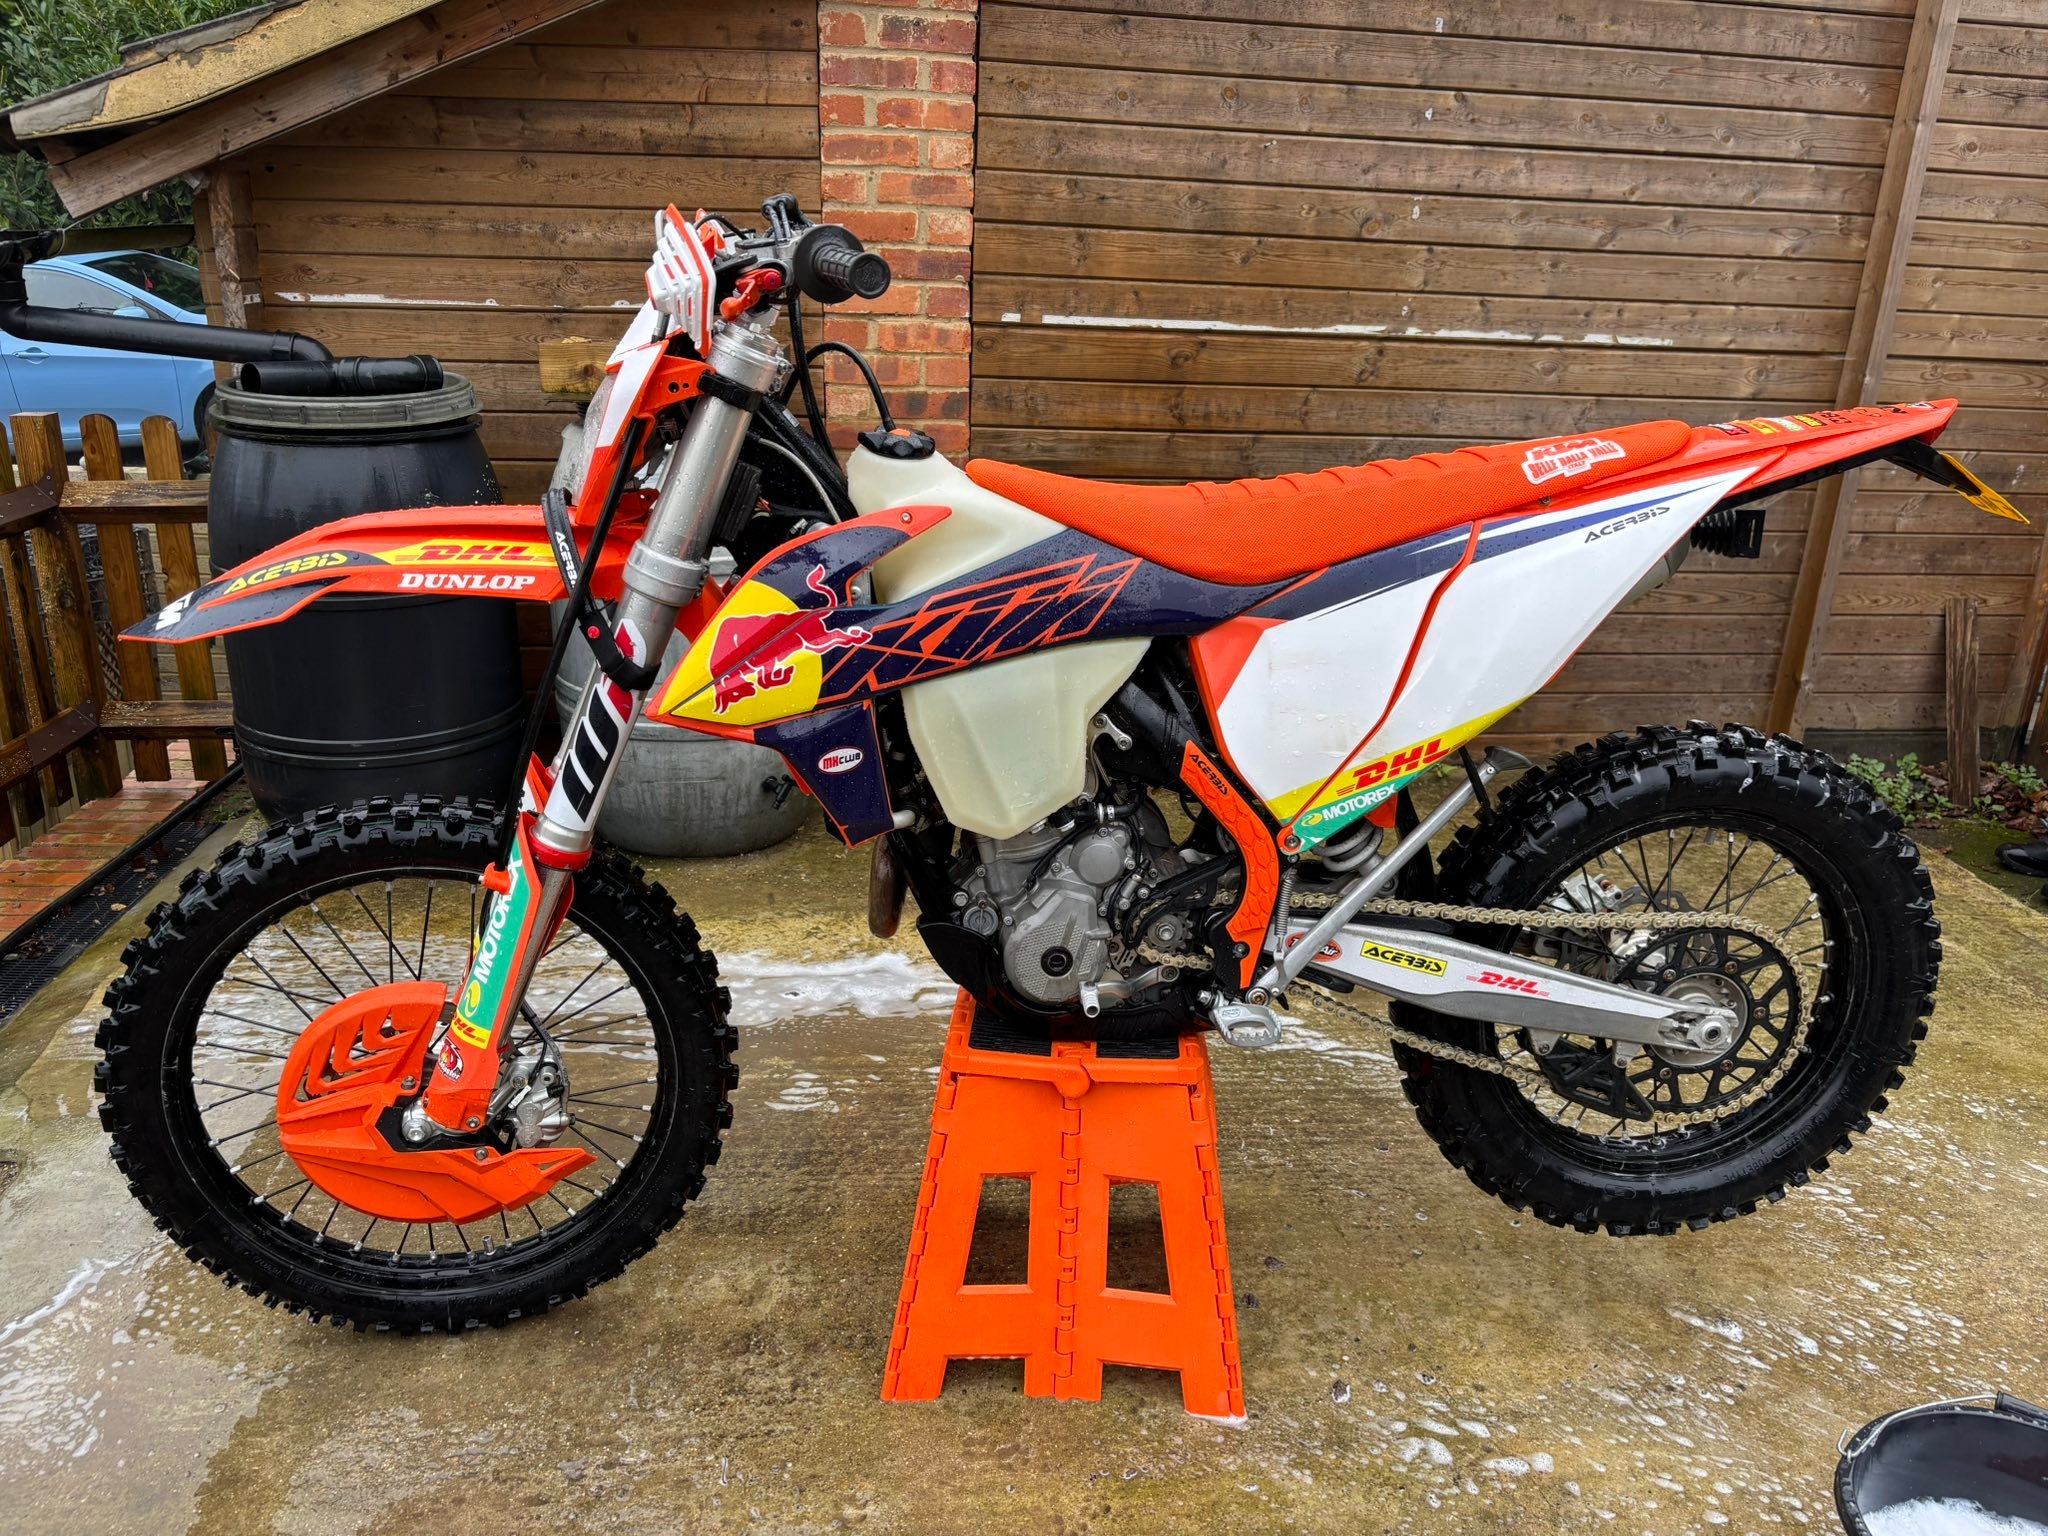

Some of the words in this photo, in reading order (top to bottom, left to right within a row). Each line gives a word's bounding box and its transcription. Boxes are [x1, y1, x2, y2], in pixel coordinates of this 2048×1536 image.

[1528, 459, 1558, 479] SELLE
[1558, 451, 1589, 466] DALLA
[1589, 442, 1619, 458] VALLE
[1567, 460, 1586, 470] ITALY
[416, 545, 535, 561] DHL
[397, 573, 536, 590] DUNLOP
[1352, 738, 1450, 790] DHL
[1322, 783, 1398, 822] MOTOREX
[1476, 970, 1541, 994] DHL
